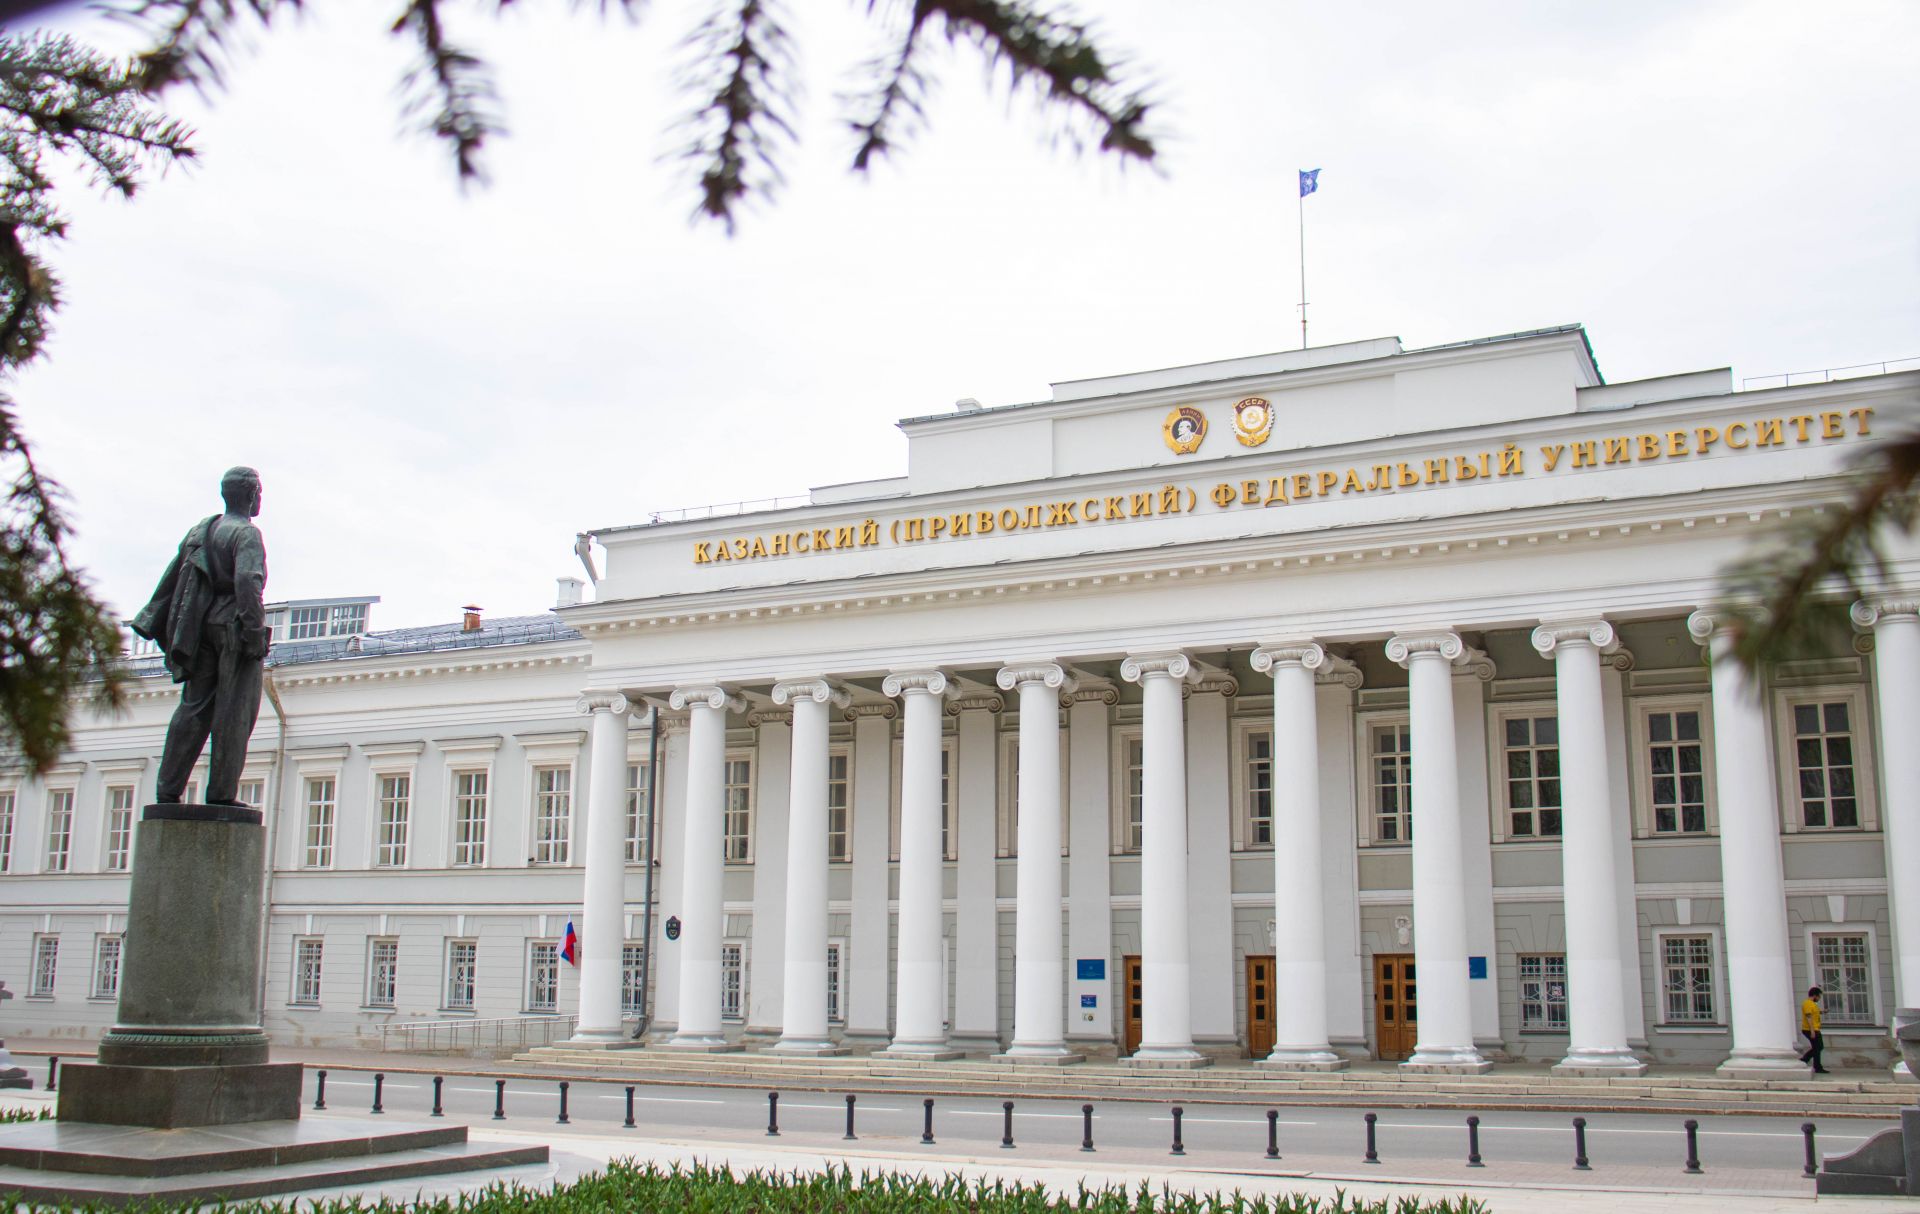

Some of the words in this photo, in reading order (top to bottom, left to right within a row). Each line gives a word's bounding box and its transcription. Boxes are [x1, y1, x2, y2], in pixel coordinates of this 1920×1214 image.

[1239, 398, 1263, 409] СССР
[693, 518, 879, 564] КАЗАНСКИЙ
[889, 484, 1198, 544] (ПРИВОЛЖСКИЙ)
[1209, 443, 1524, 508] ФЕДЕРАЛЬНЫЙ
[1540, 406, 1875, 472] УНИВЕРСИТЕТ
